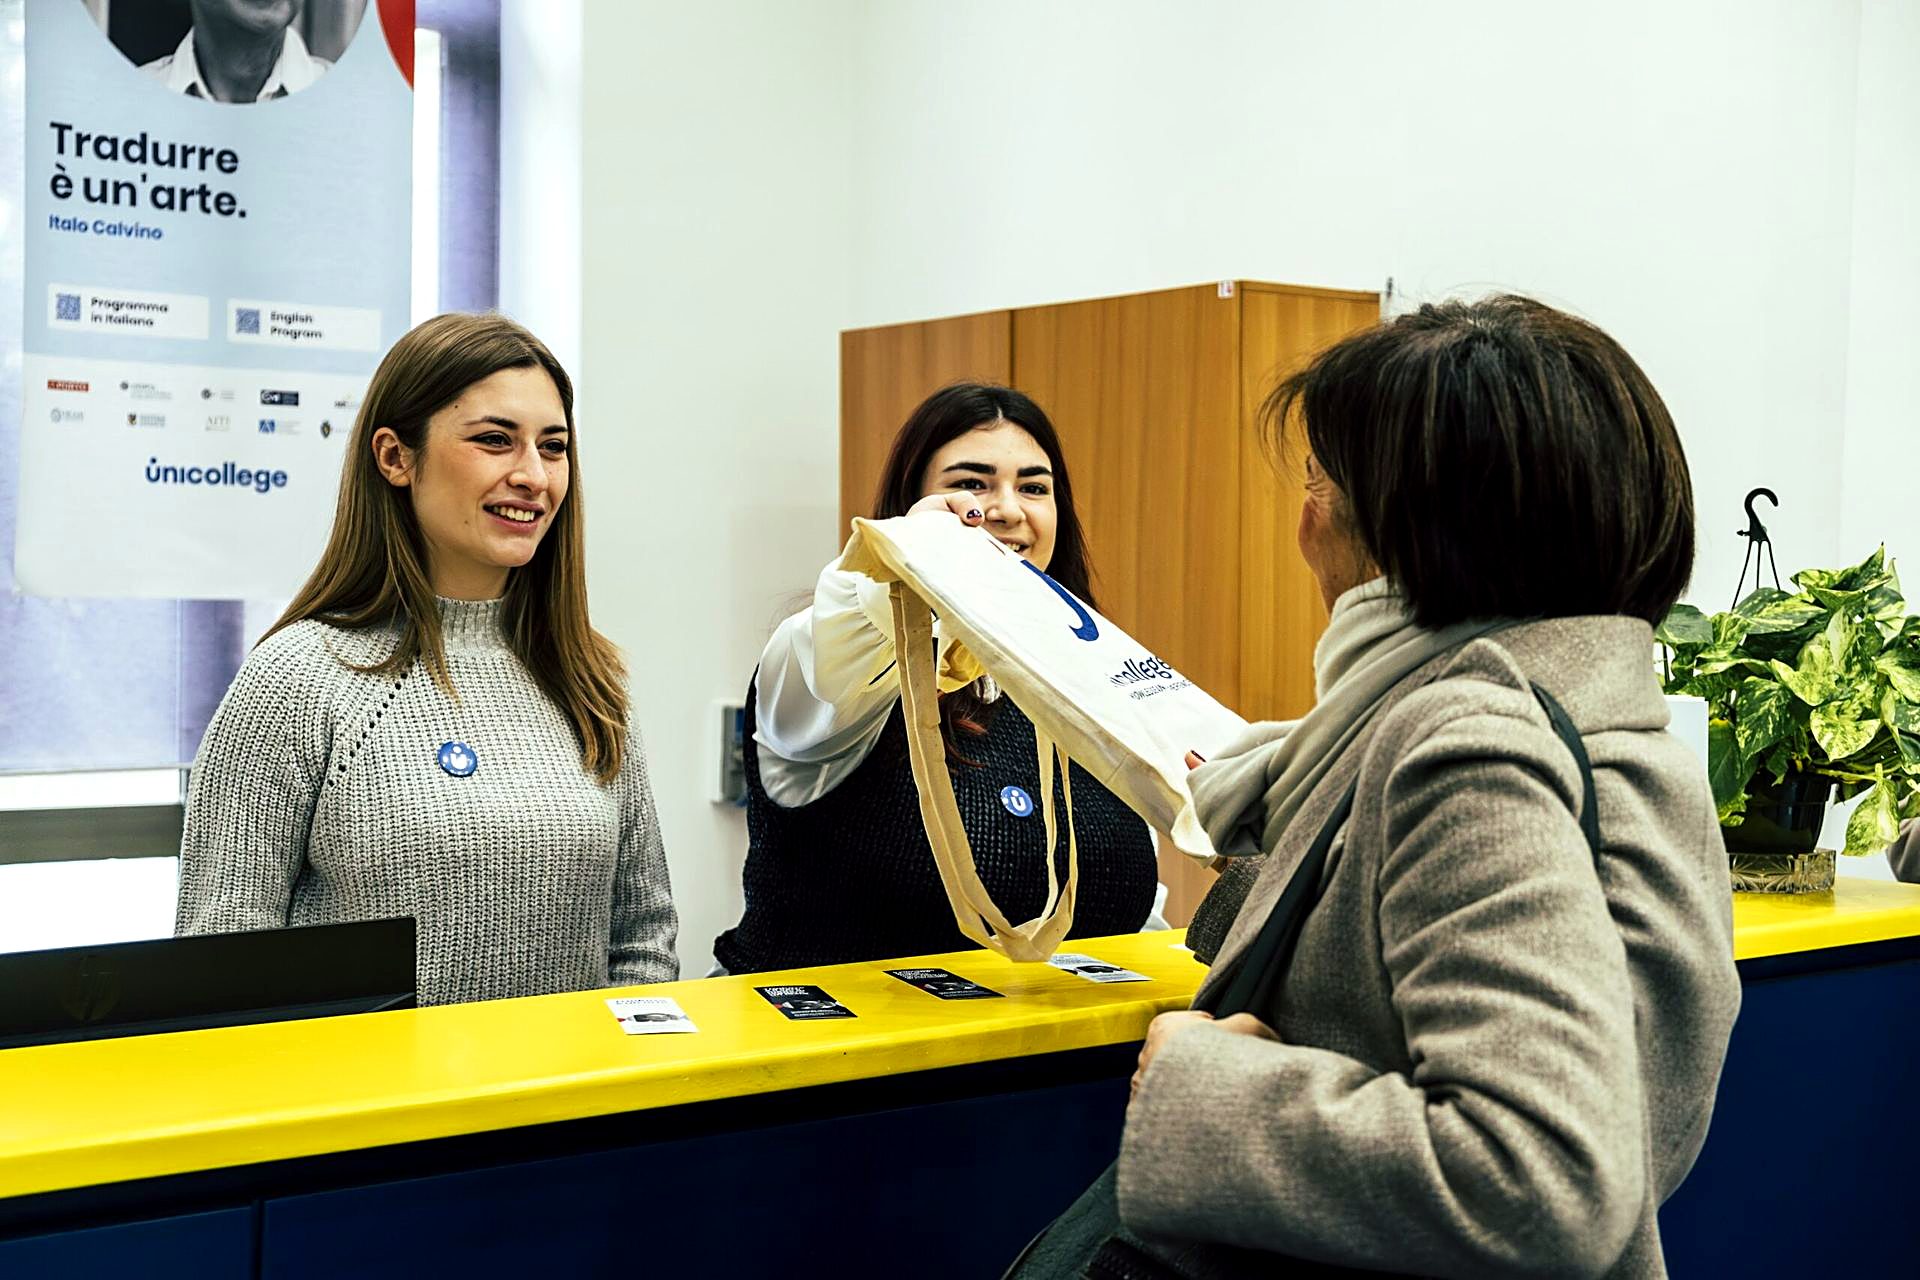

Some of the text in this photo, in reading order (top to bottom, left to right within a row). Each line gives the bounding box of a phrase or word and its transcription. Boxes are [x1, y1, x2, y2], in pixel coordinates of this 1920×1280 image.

[49, 121, 239, 174] Tradurre
[50, 163, 247, 219] è un'arte.
[48, 214, 163, 240] Italo Calvino
[90, 297, 169, 313] Programma
[90, 314, 103, 323] in
[269, 311, 313, 325] English
[269, 326, 323, 340] Program
